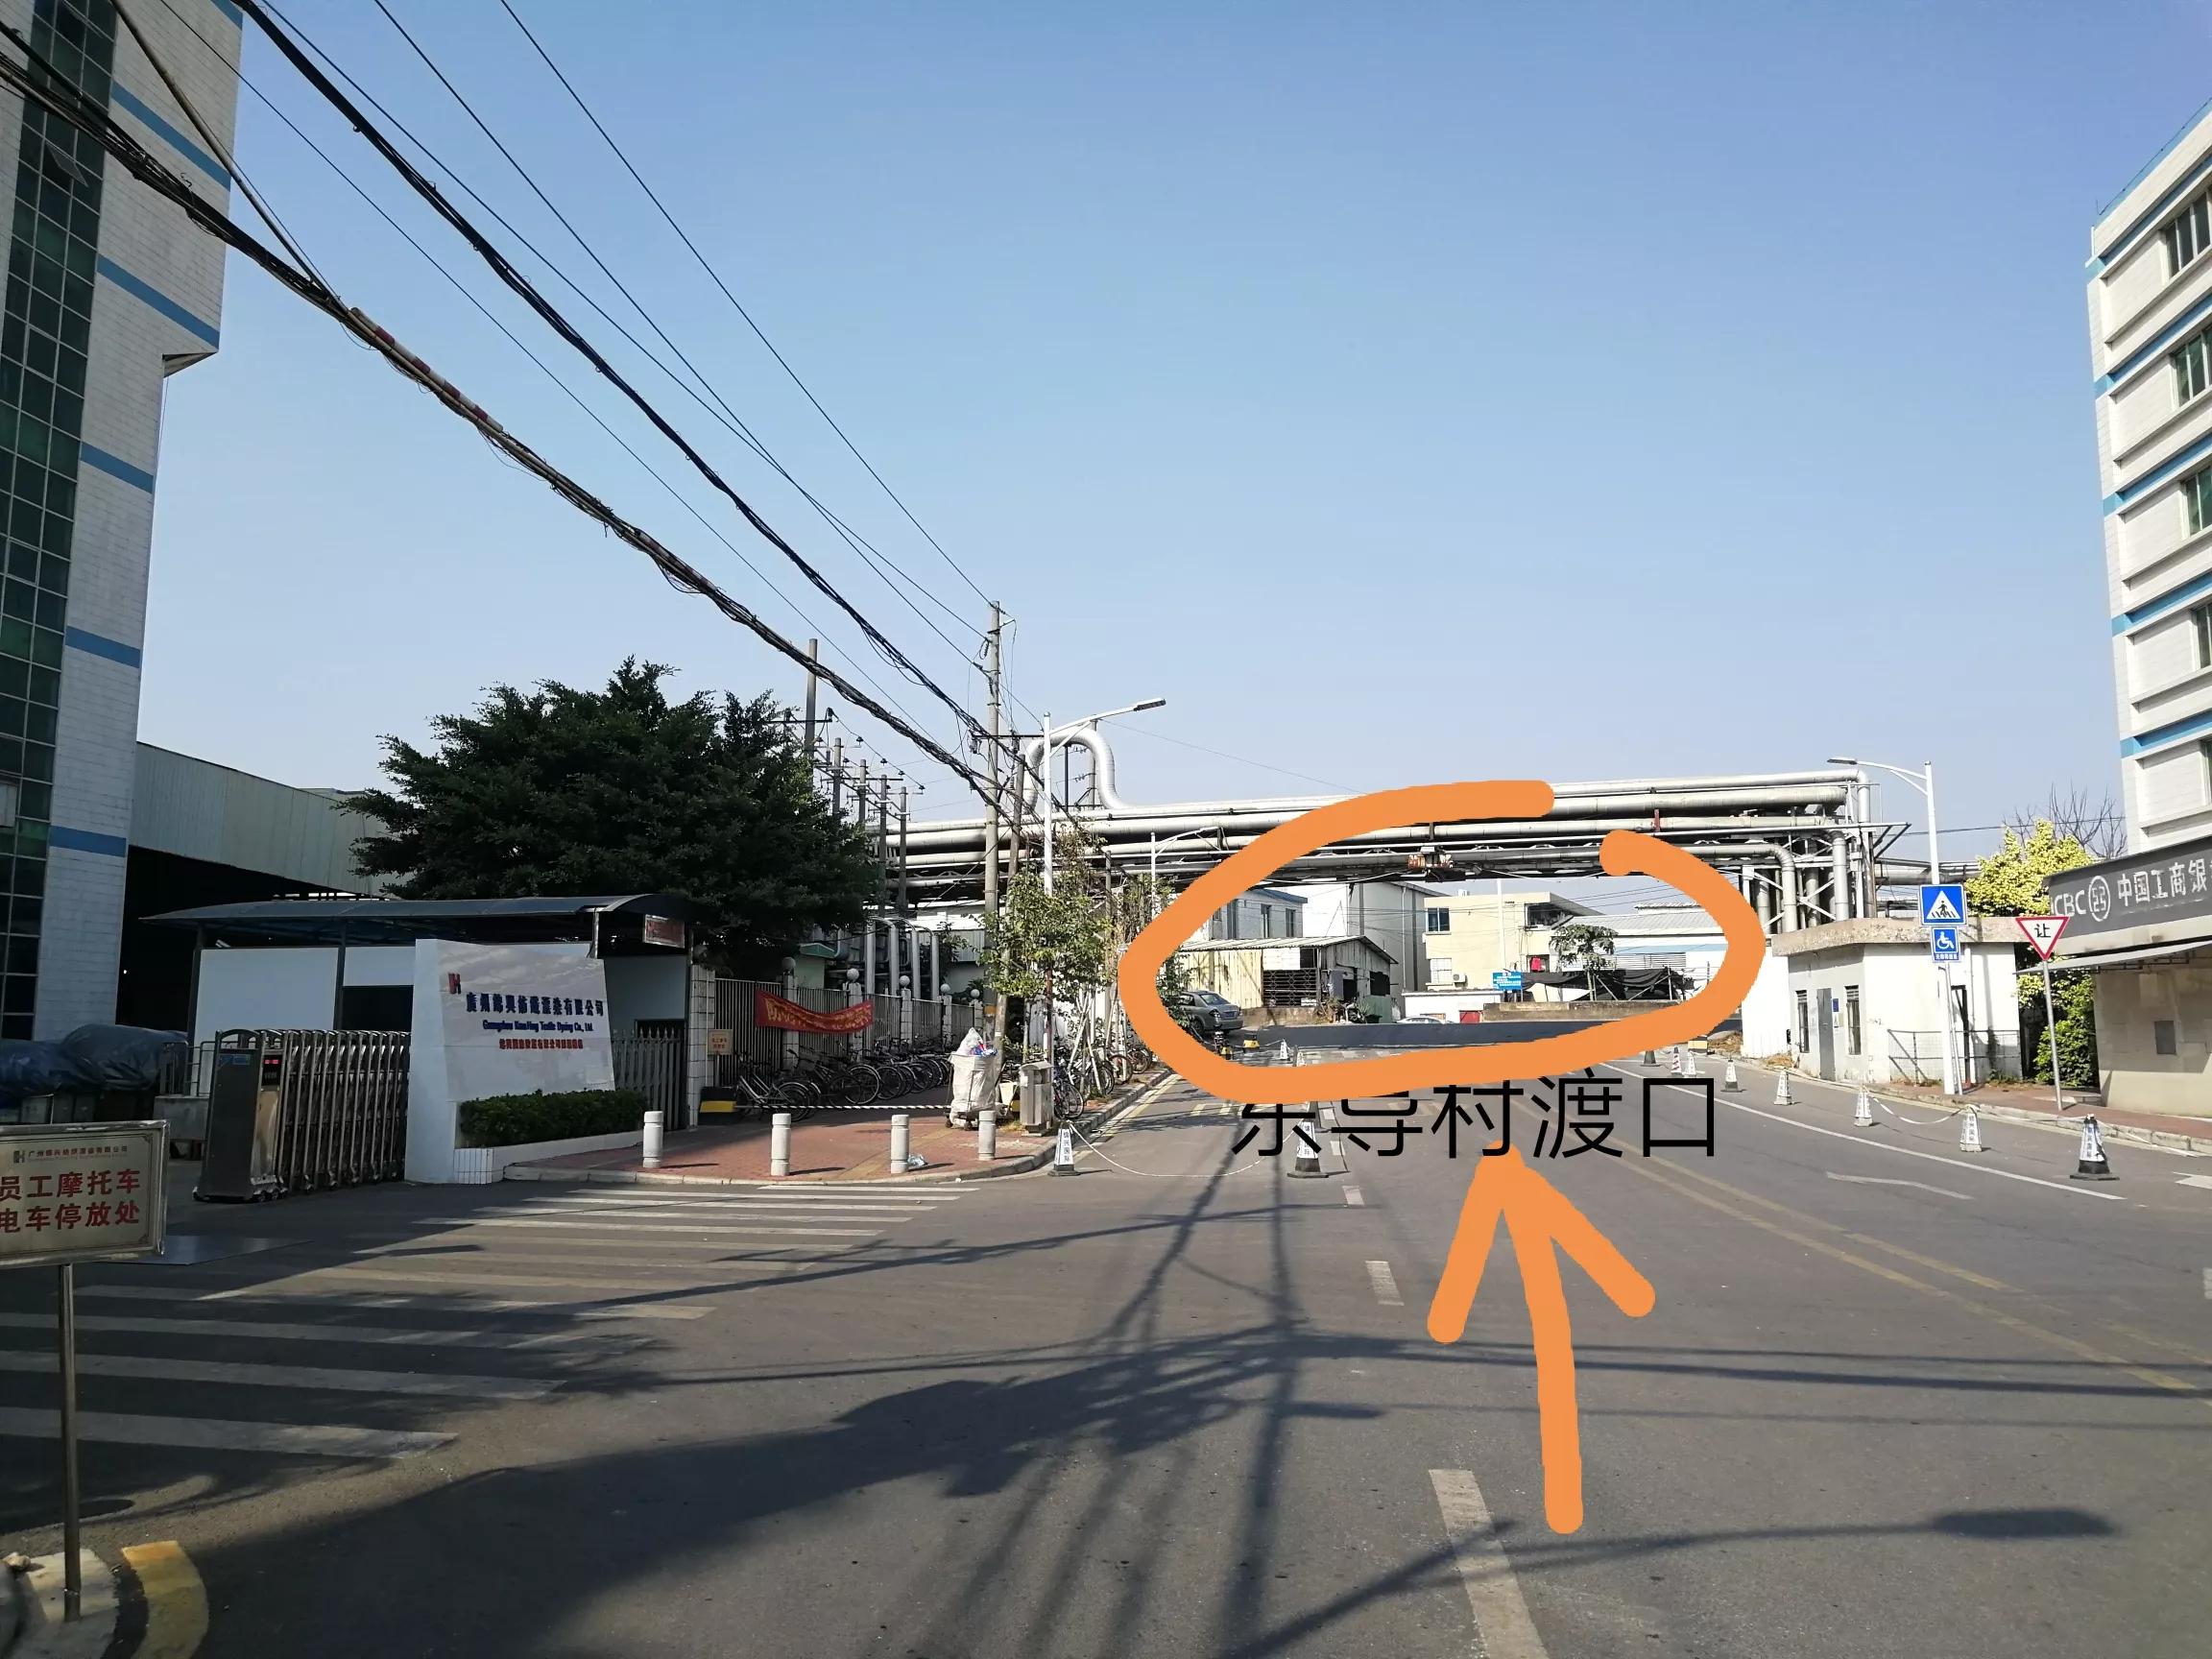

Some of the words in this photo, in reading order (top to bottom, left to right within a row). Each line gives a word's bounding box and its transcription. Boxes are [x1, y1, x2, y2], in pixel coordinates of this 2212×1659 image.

[2051, 889, 2086, 918] ICBC
[2117, 858, 2212, 907] 中国工商银
[2034, 924, 2051, 938] 让
[0, 1168, 141, 1201] 员工摩托车
[0, 1200, 140, 1233] 电车停放处
